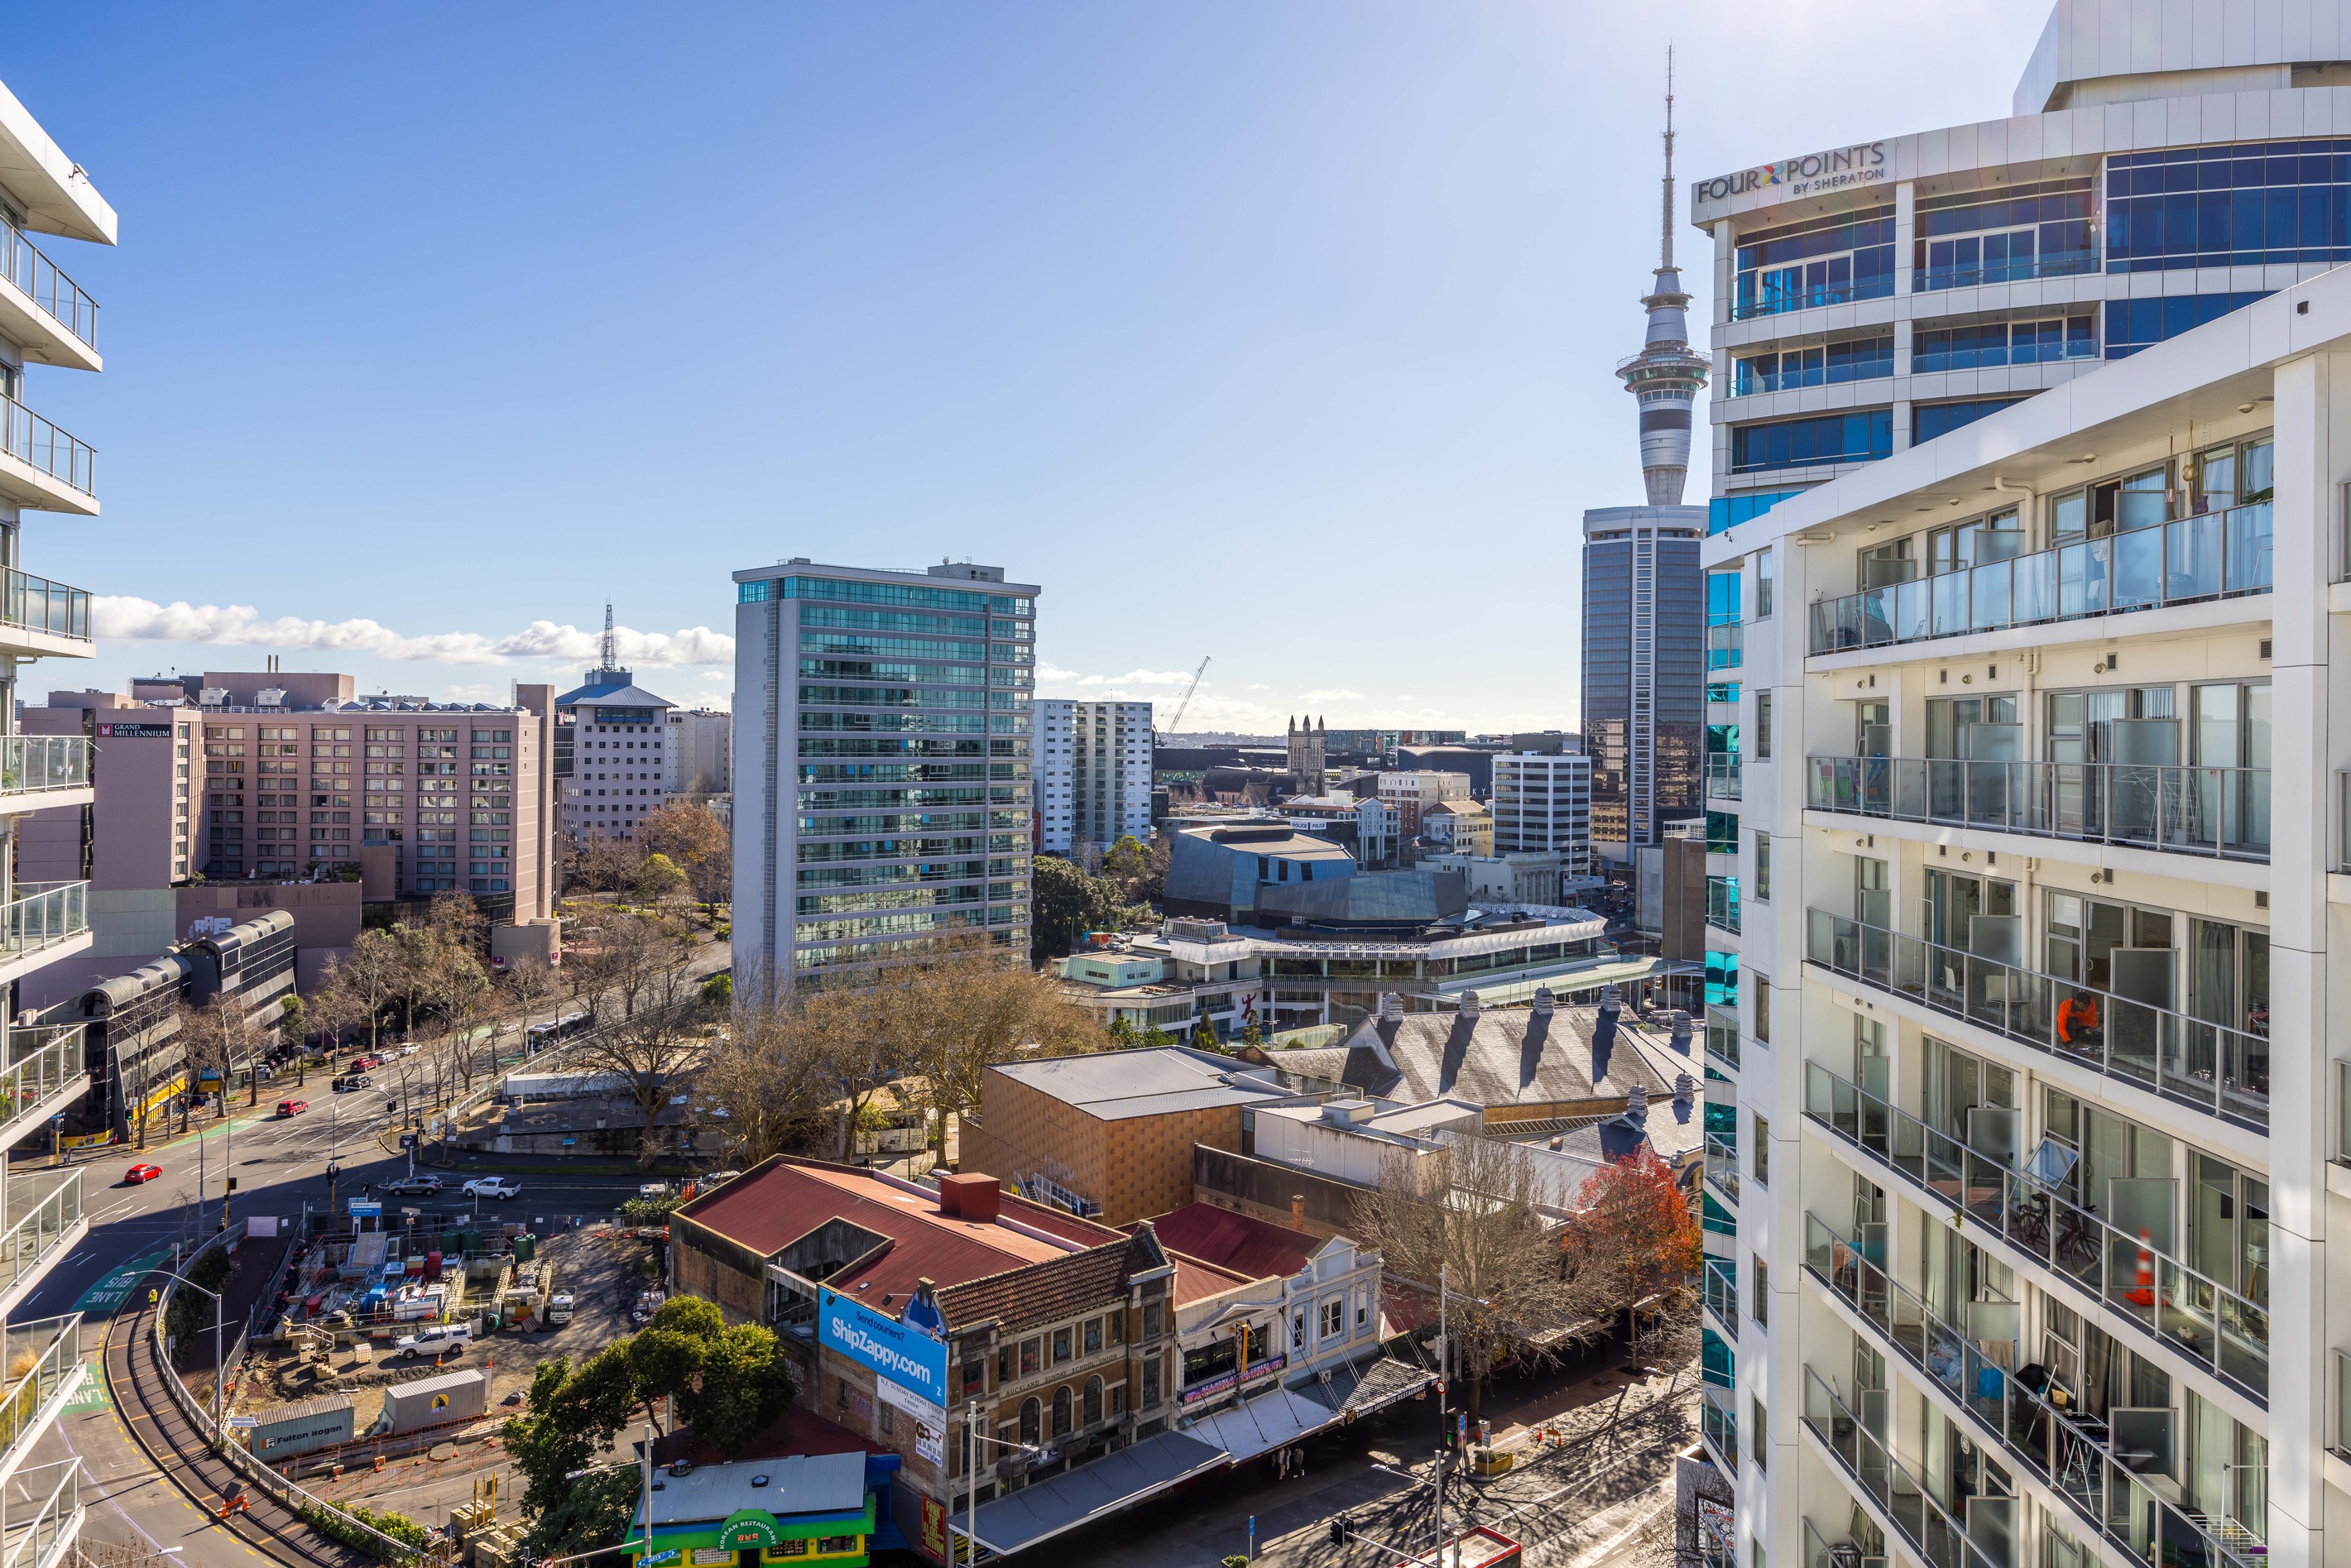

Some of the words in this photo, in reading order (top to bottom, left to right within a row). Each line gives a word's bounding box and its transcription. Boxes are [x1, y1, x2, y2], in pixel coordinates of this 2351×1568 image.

[1698, 170, 1761, 203] FOUR
[1787, 142, 1884, 181] POINTS
[1793, 182, 1809, 194] BY
[1815, 168, 1884, 190] SHERATON
[104, 1277, 135, 1288] BUS
[86, 1291, 124, 1303] LANE
[856, 1311, 873, 1326] Send
[874, 1321, 905, 1342] couriers?
[832, 1317, 931, 1384] ShipZappy.com
[1005, 1380, 1039, 1396] AUCKLAND
[1044, 1370, 1068, 1383] SUNDAY
[1072, 1361, 1096, 1374] SCHOOL
[1099, 1354, 1117, 1364] UNION
[1215, 1378, 1229, 1387] HOME
[1250, 1363, 1269, 1373] COMEDY
[880, 1379, 889, 1387] N.Z.
[890, 1383, 909, 1397] SUNDAY
[909, 1393, 927, 1407] SCHOOL
[928, 1403, 943, 1417] UNION
[904, 1398, 919, 1410] Centre
[1356, 1407, 1374, 1418] TANUKI
[1374, 1397, 1397, 1411] JAPANESE
[1397, 1384, 1426, 1402] RESTAURANT
[277, 1431, 309, 1444] Fulton
[311, 1425, 343, 1437] Hogan
[719, 1524, 739, 1550] KOREAN
[740, 1521, 776, 1545] RESTAURANT
[647, 1555, 661, 1563] QUEEN
